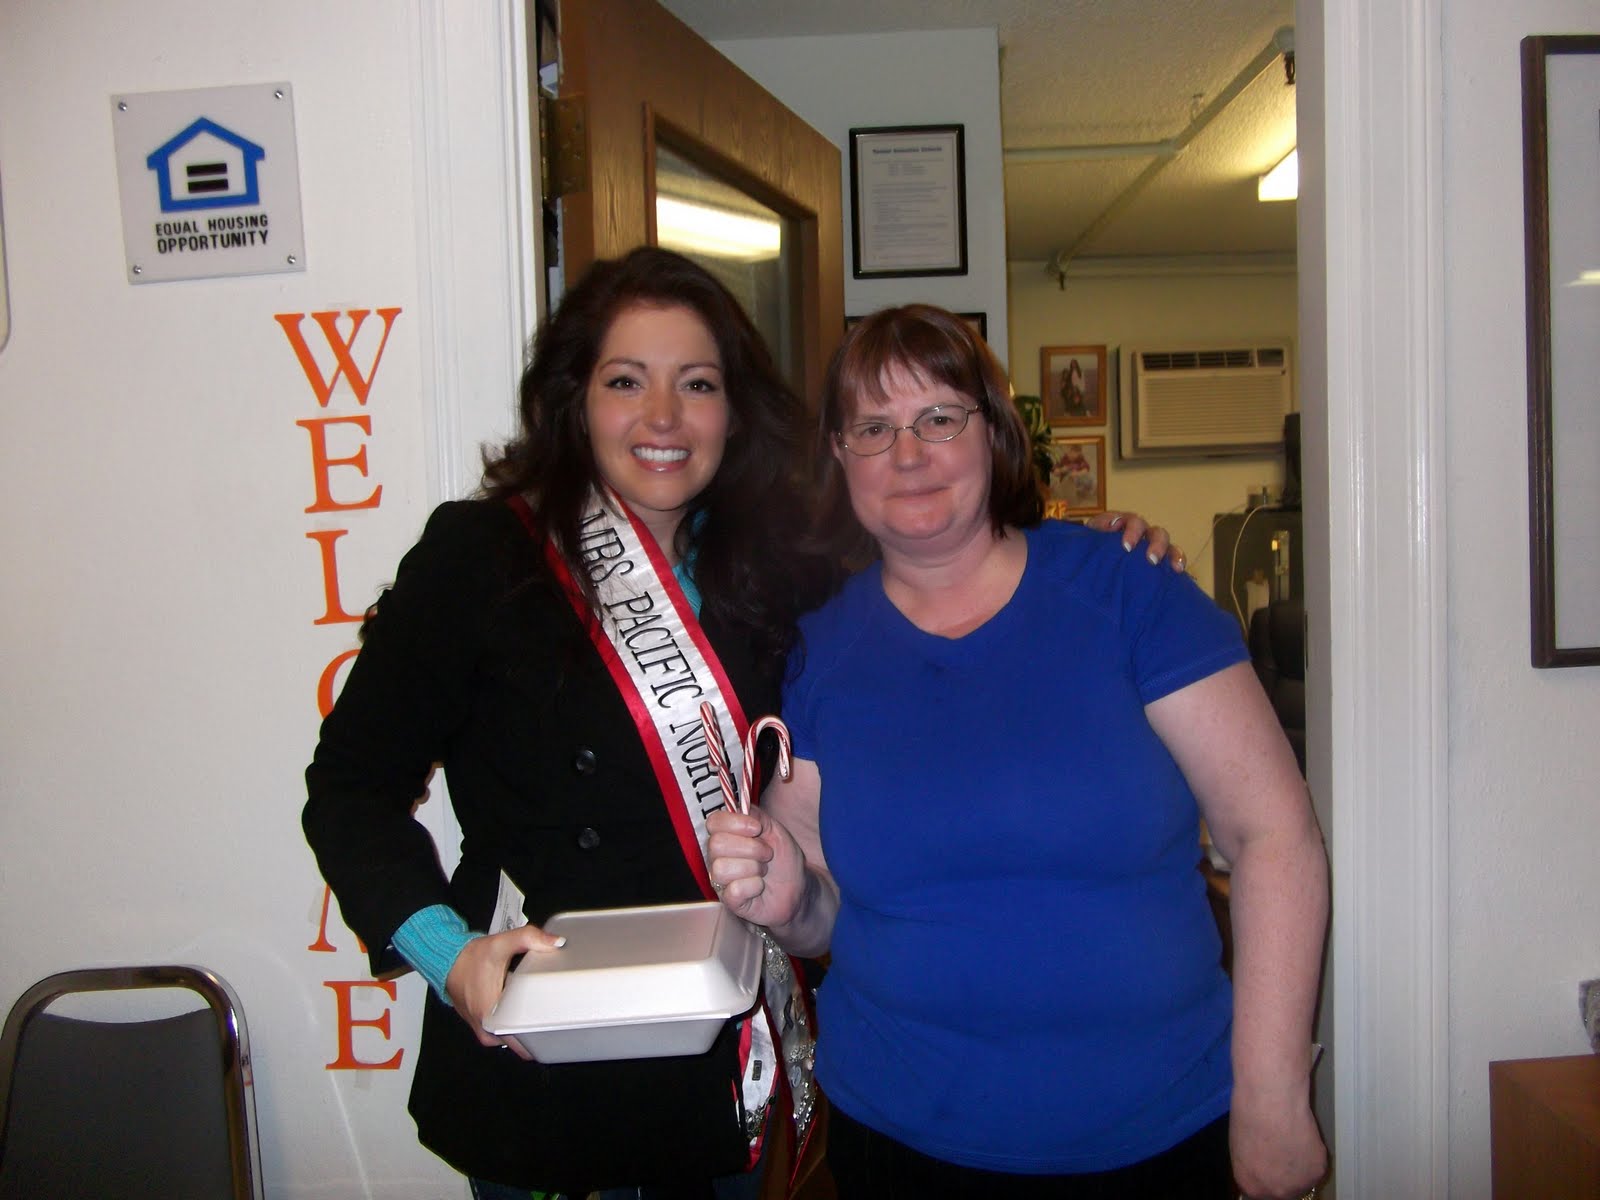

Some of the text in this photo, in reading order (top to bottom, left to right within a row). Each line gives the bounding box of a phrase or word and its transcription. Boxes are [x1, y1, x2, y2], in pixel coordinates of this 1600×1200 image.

[155, 214, 269, 236] EQUAL HOUSING
[156, 231, 269, 254] OPPORTUNITY
[604, 592, 705, 709] PACIFIC
